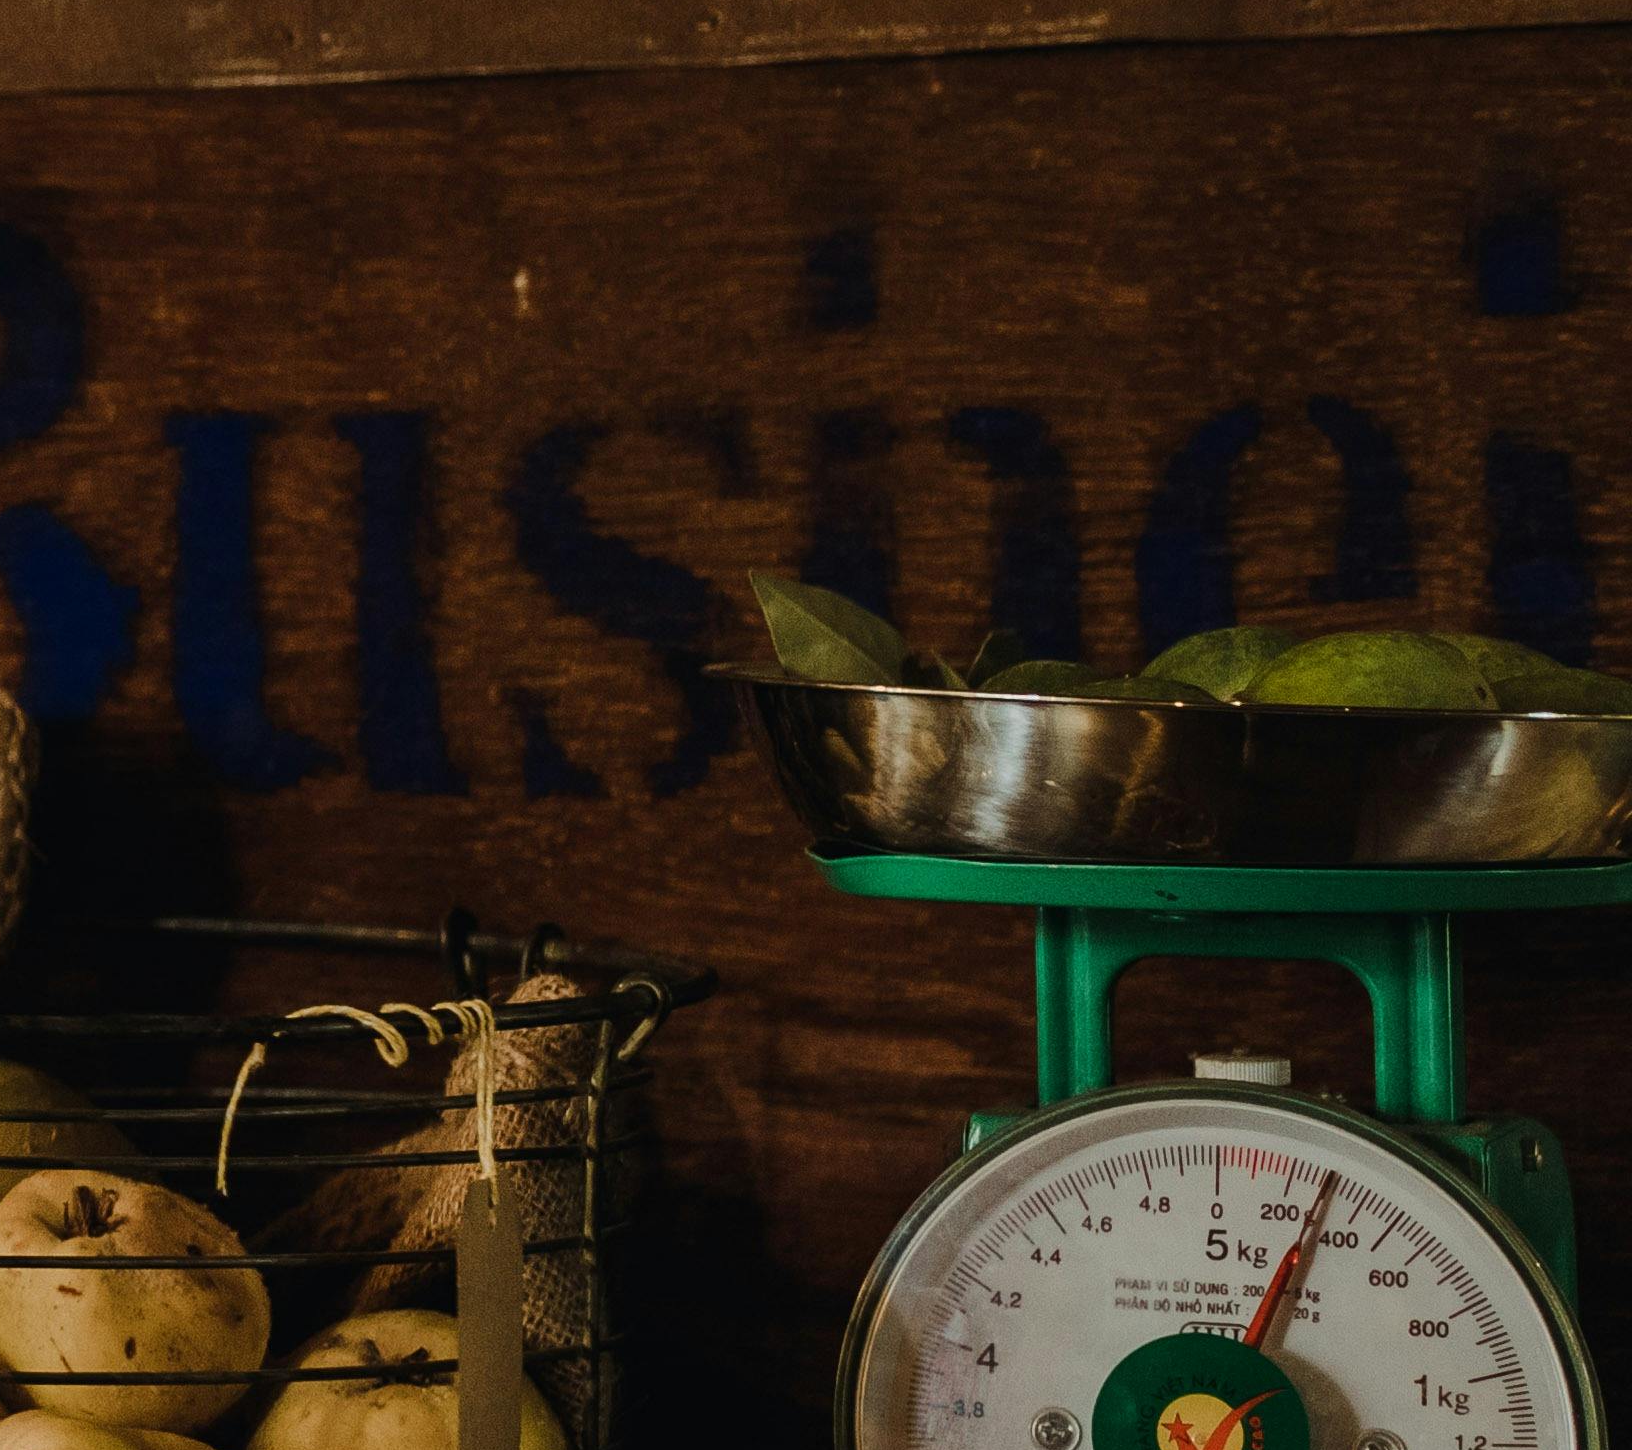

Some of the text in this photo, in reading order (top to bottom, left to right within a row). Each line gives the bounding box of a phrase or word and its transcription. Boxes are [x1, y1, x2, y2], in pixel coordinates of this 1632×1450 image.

[1139, 1195, 1171, 1215] 4,8
[1210, 1202, 1223, 1220] 0
[1260, 1203, 1299, 1222] 200
[1081, 1215, 1112, 1234] 4,6
[1205, 1229, 1268, 1269] 5 kg
[1318, 1231, 1359, 1249] 400
[1030, 1248, 1062, 1267] 4,4
[1368, 1270, 1409, 1289] 600
[990, 1291, 1022, 1309] 4,2
[1242, 1285, 1265, 1297] 200
[1305, 1287, 1320, 1302] kg
[1294, 1307, 1308, 1320] 20
[1312, 1310, 1320, 1323] g
[1408, 1319, 1450, 1338] 800
[976, 1343, 999, 1374] 4
[1414, 1374, 1471, 1416] 1 kg
[953, 1400, 985, 1419] 3,8
